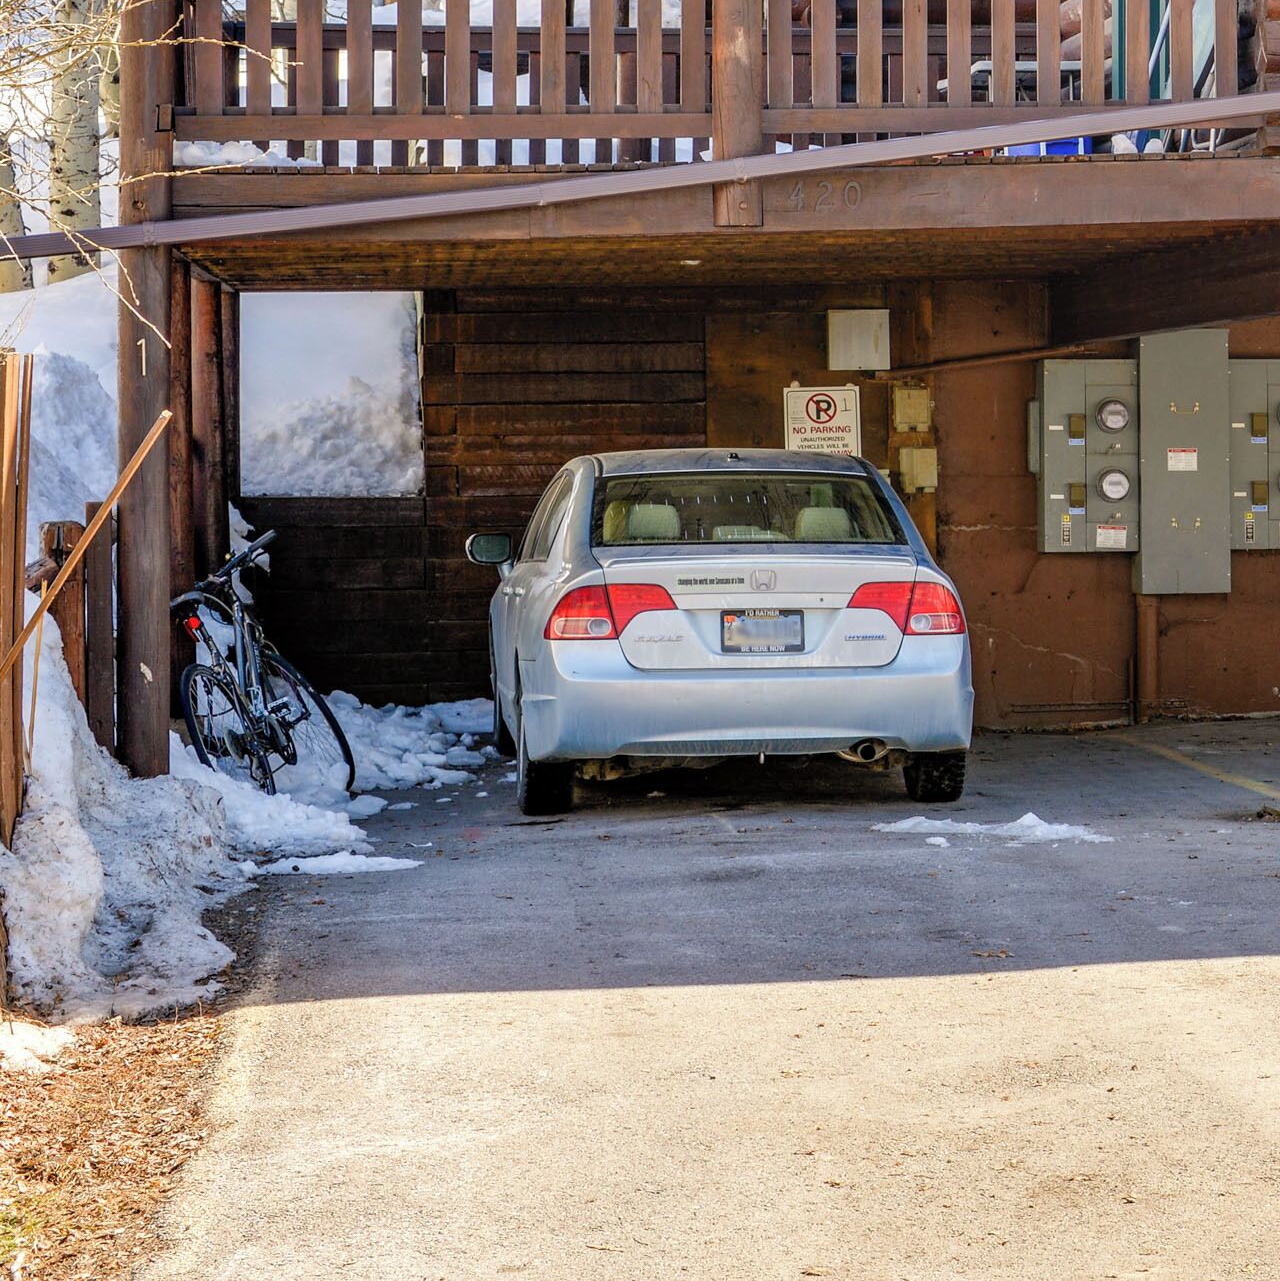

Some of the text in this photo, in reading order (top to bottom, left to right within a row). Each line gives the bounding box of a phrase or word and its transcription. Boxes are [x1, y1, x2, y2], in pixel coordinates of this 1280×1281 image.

[790, 181, 862, 213] 420
[136, 338, 147, 377] 1
[793, 425, 852, 435] NO PARKING
[755, 608, 780, 616] RATHER
[847, 632, 886, 640] HYBRID
